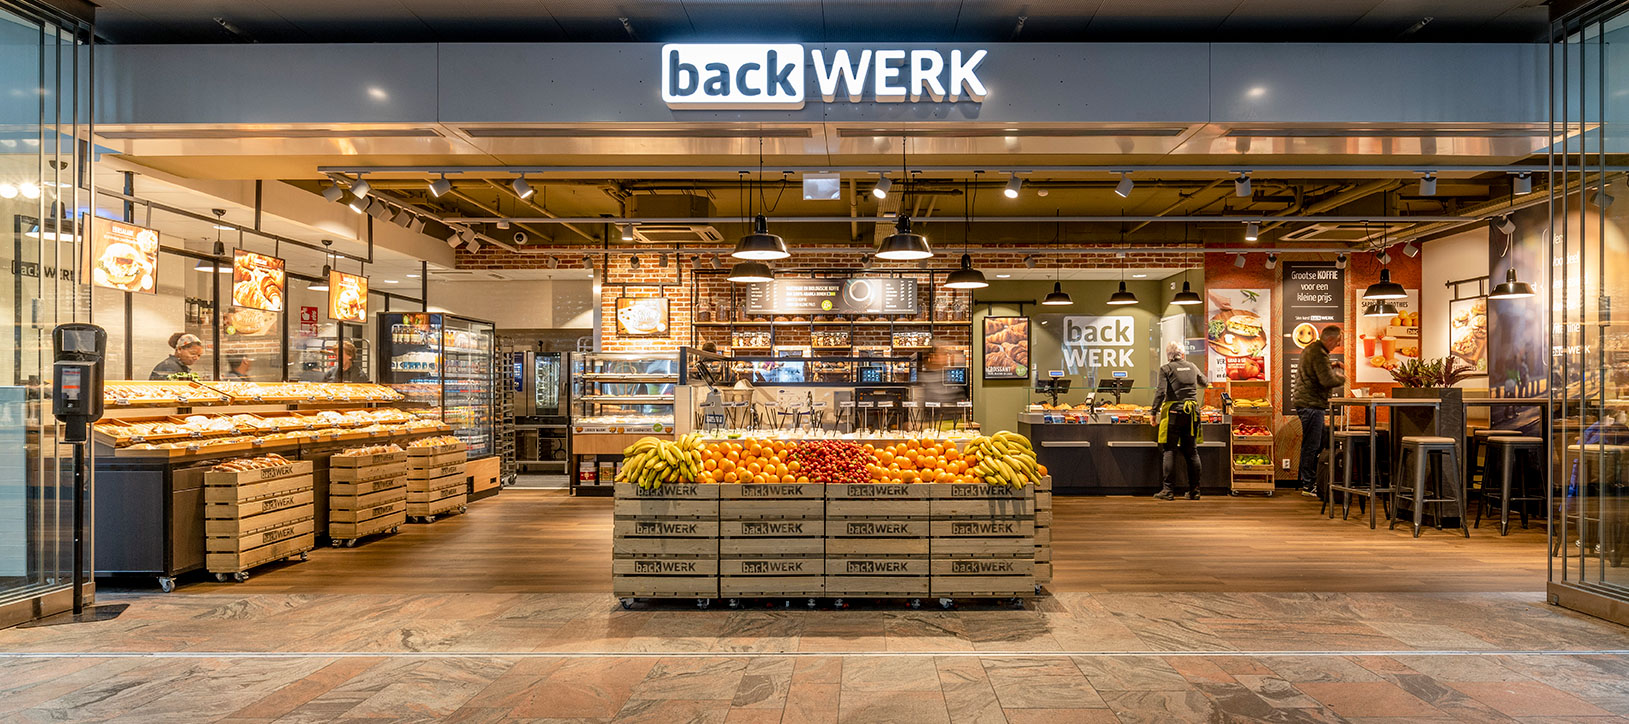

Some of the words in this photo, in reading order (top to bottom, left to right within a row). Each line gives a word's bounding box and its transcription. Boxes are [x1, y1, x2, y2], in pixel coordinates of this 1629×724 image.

[669, 49, 796, 97] back
[811, 49, 988, 98] WERK
[1291, 271, 1317, 280] Grootse
[1317, 270, 1338, 280] KOFFIE
[1300, 283, 1315, 291] voor
[1316, 283, 1329, 291] een
[1297, 292, 1317, 302] kleine
[1317, 292, 1332, 304] prijs
[1067, 319, 1131, 343] back
[1063, 348, 1134, 368] WERK
[664, 485, 698, 496] WERK
[741, 485, 769, 497] back
[769, 484, 803, 496] WERK
[847, 484, 874, 497] back
[875, 484, 909, 496] WERK
[951, 484, 978, 497] back
[979, 485, 1013, 496] WERK
[635, 522, 662, 534] back
[663, 523, 697, 534] WERK
[741, 522, 769, 534] back
[769, 523, 803, 534] WERK
[847, 522, 874, 535] back
[875, 523, 909, 534] WERK
[952, 522, 979, 535] back
[979, 523, 1013, 534] WERK
[635, 561, 662, 573] back
[662, 562, 696, 572] WERK
[741, 561, 769, 573] back
[769, 562, 803, 572] WERK
[846, 561, 874, 573] back
[874, 562, 909, 572] WERK
[952, 561, 979, 573] back
[980, 562, 1014, 572] WERK
